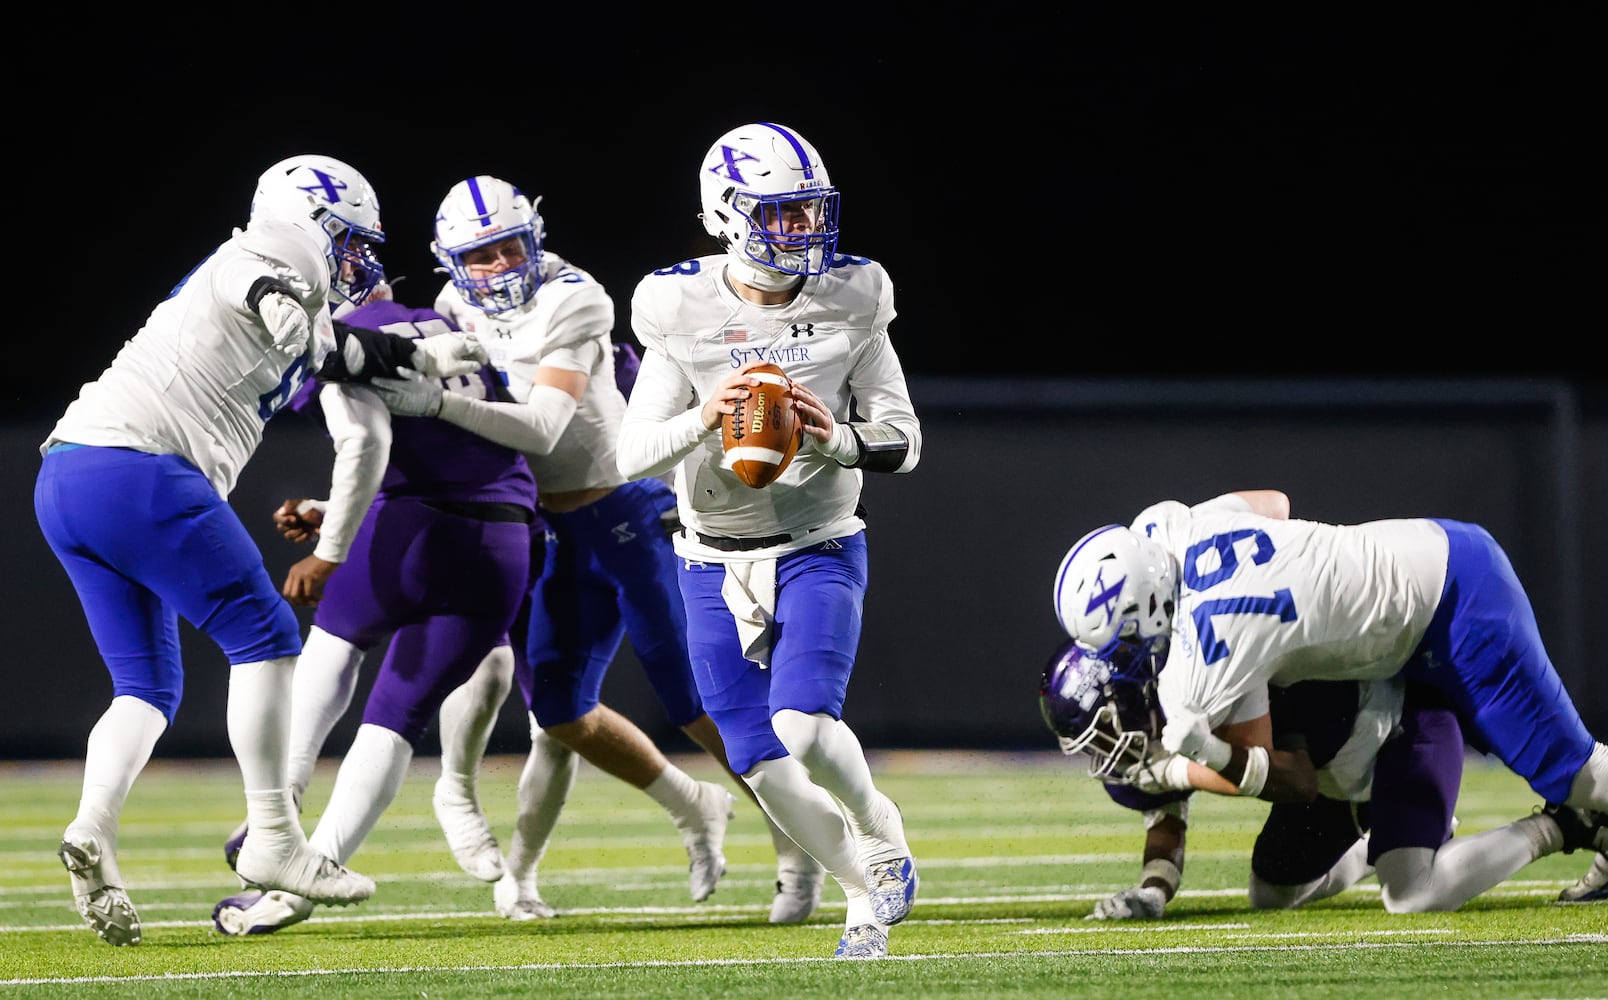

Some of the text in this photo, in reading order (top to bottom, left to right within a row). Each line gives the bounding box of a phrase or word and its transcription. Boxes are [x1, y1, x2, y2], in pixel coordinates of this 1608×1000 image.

[296, 167, 348, 205] X
[708, 144, 761, 187] X
[752, 346, 811, 364] XAVIER
[751, 392, 767, 434] Wilson
[1084, 565, 1128, 627] X
[1183, 528, 1298, 666] 79
